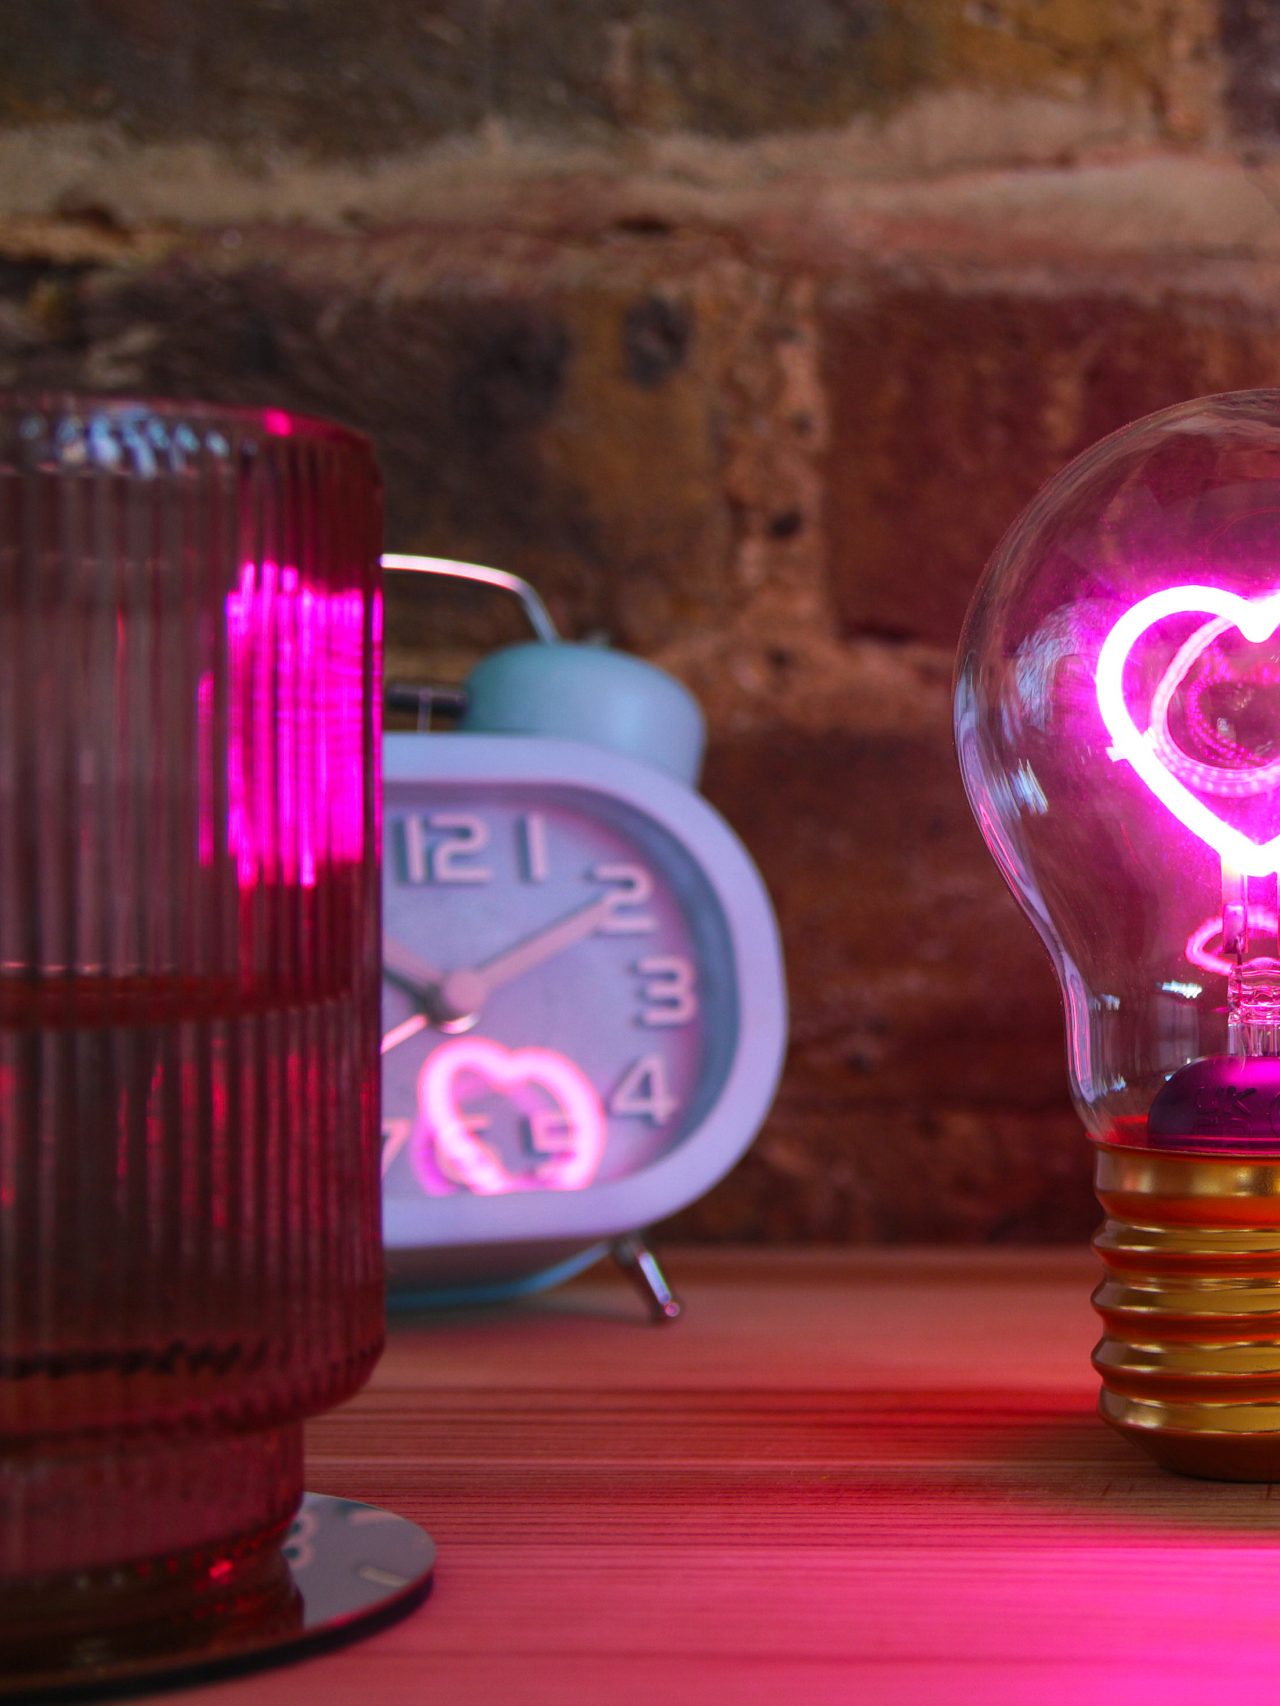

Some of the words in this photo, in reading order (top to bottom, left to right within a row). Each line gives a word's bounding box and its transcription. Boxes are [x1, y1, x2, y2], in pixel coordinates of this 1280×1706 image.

[405, 812, 491, 884] 12
[528, 813, 547, 883] 1
[594, 864, 656, 934] 2
[636, 956, 697, 1027] 3
[610, 1056, 677, 1127] 4
